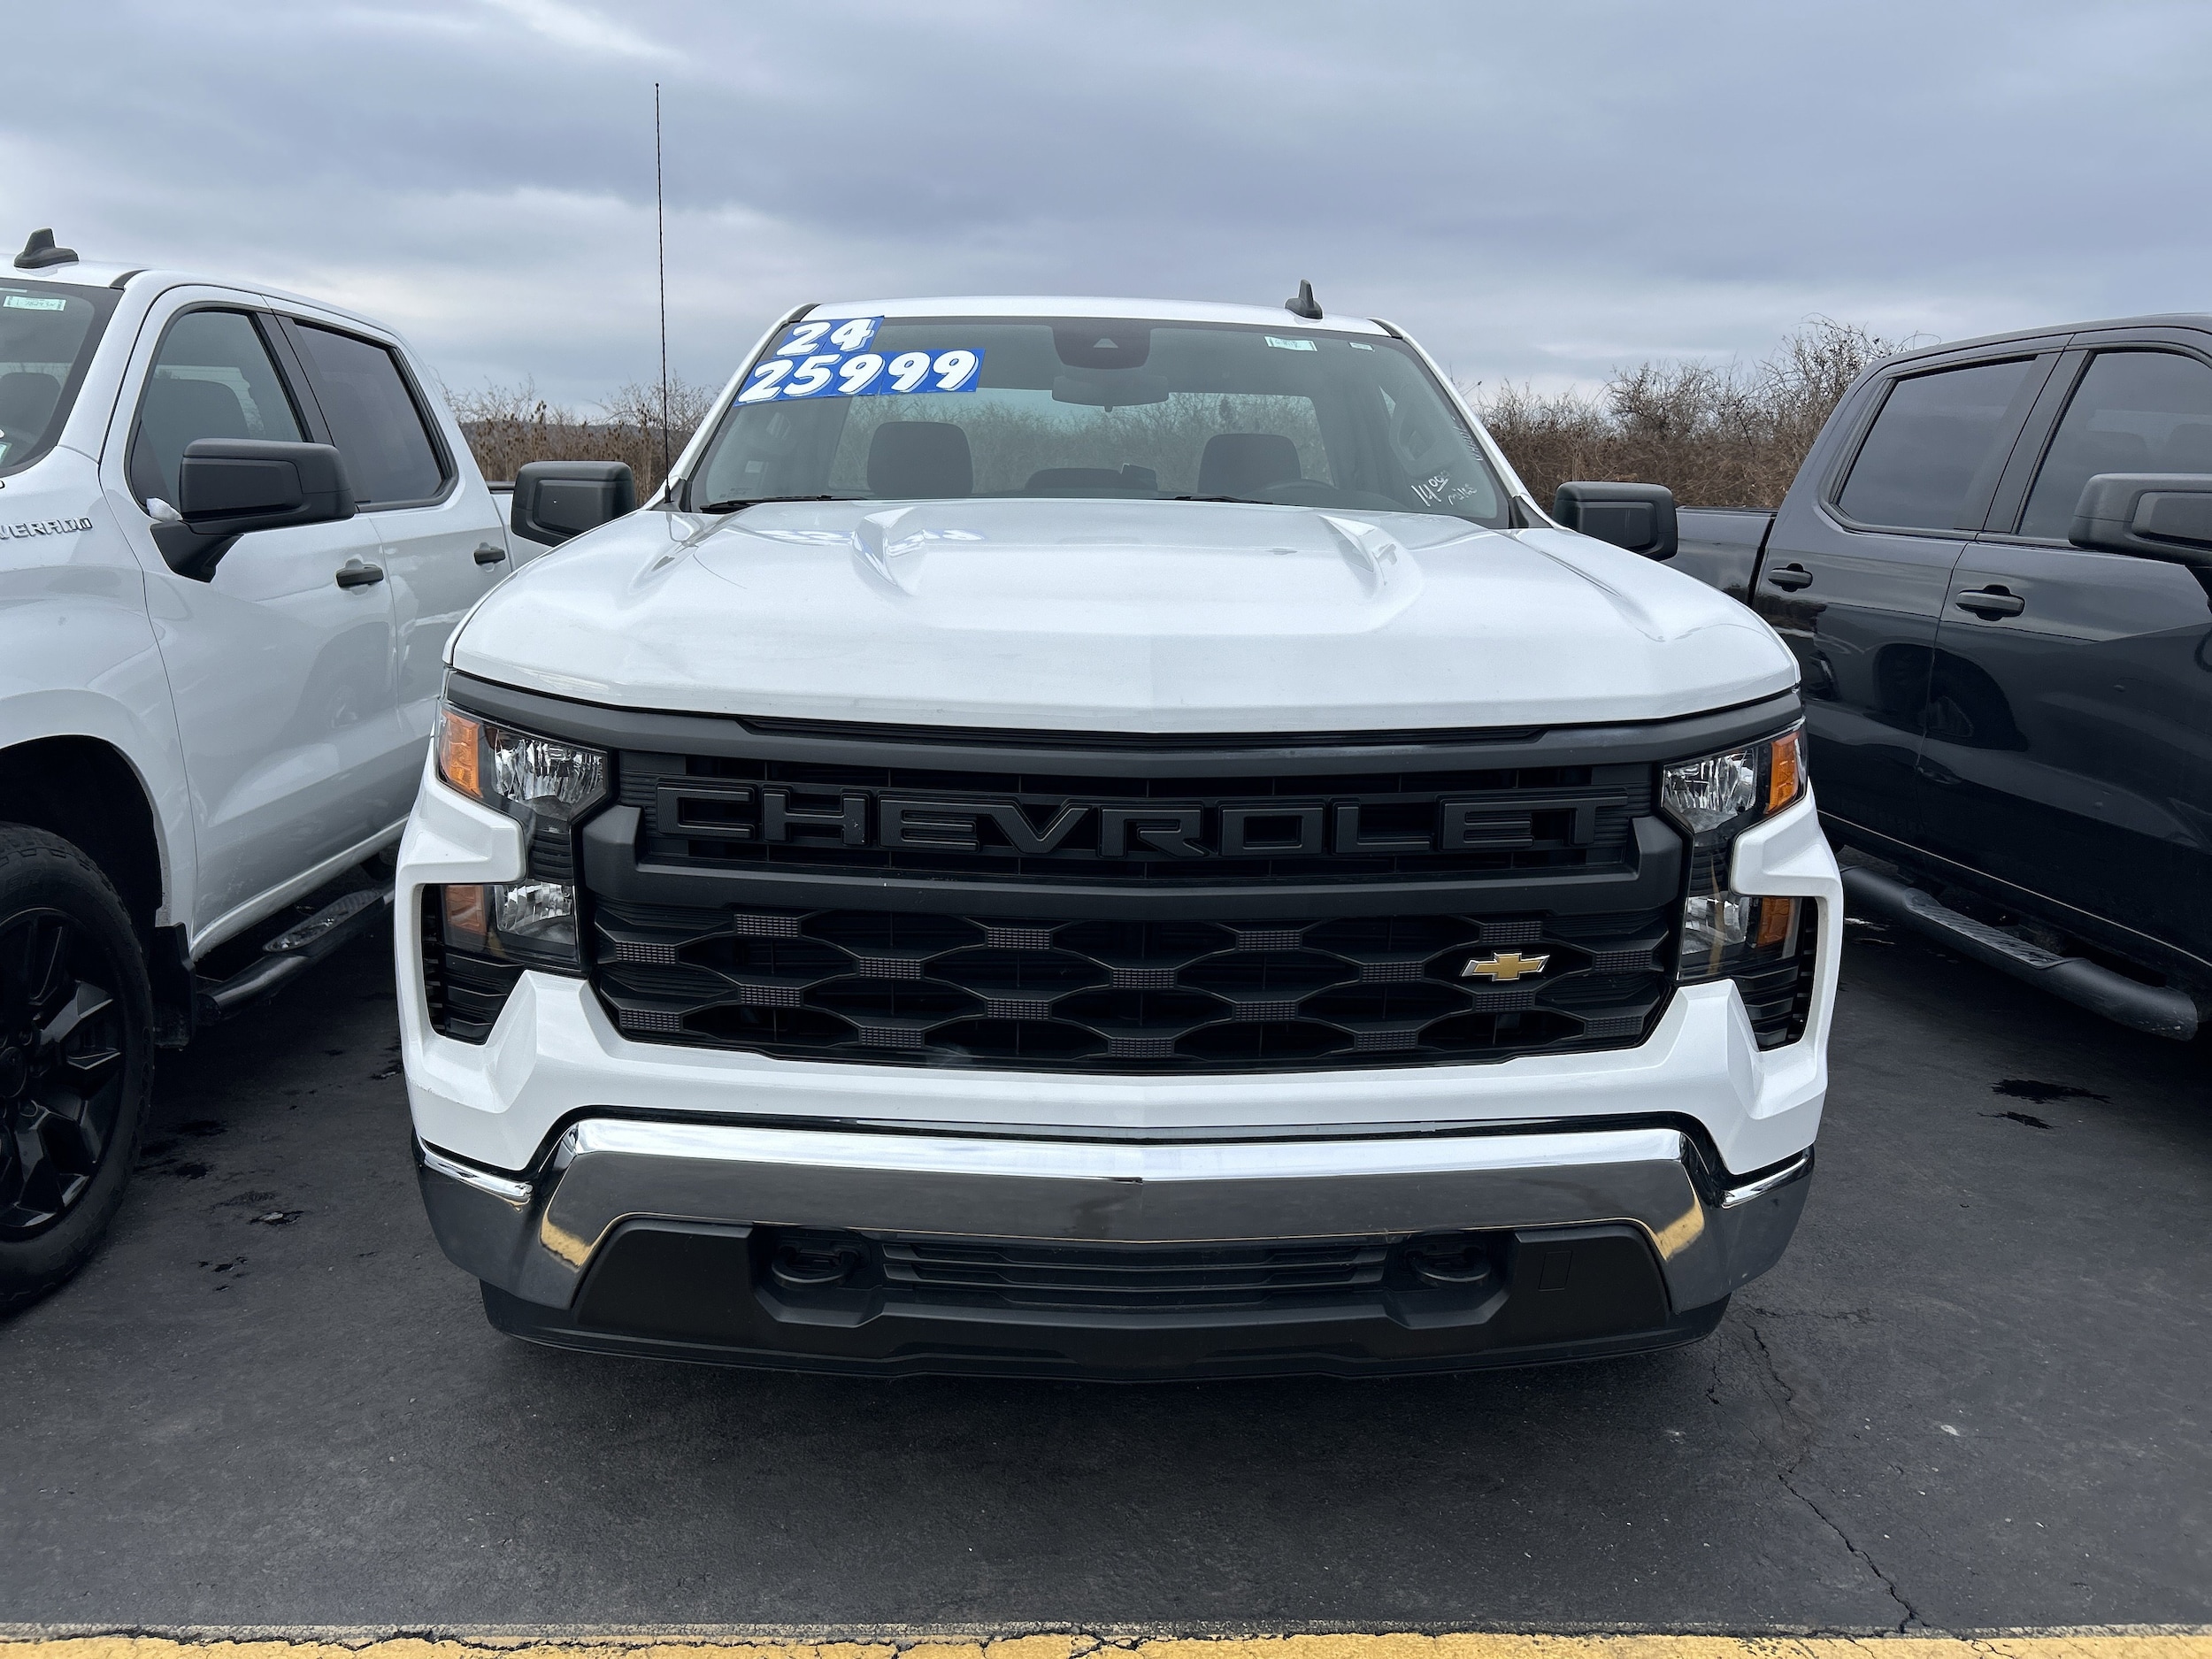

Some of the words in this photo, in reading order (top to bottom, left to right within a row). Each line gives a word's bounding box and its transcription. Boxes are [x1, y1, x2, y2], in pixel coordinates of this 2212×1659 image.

[775, 319, 875, 356] 24
[738, 349, 979, 403] 25999
[656, 779, 1630, 857] CHEVROLET
